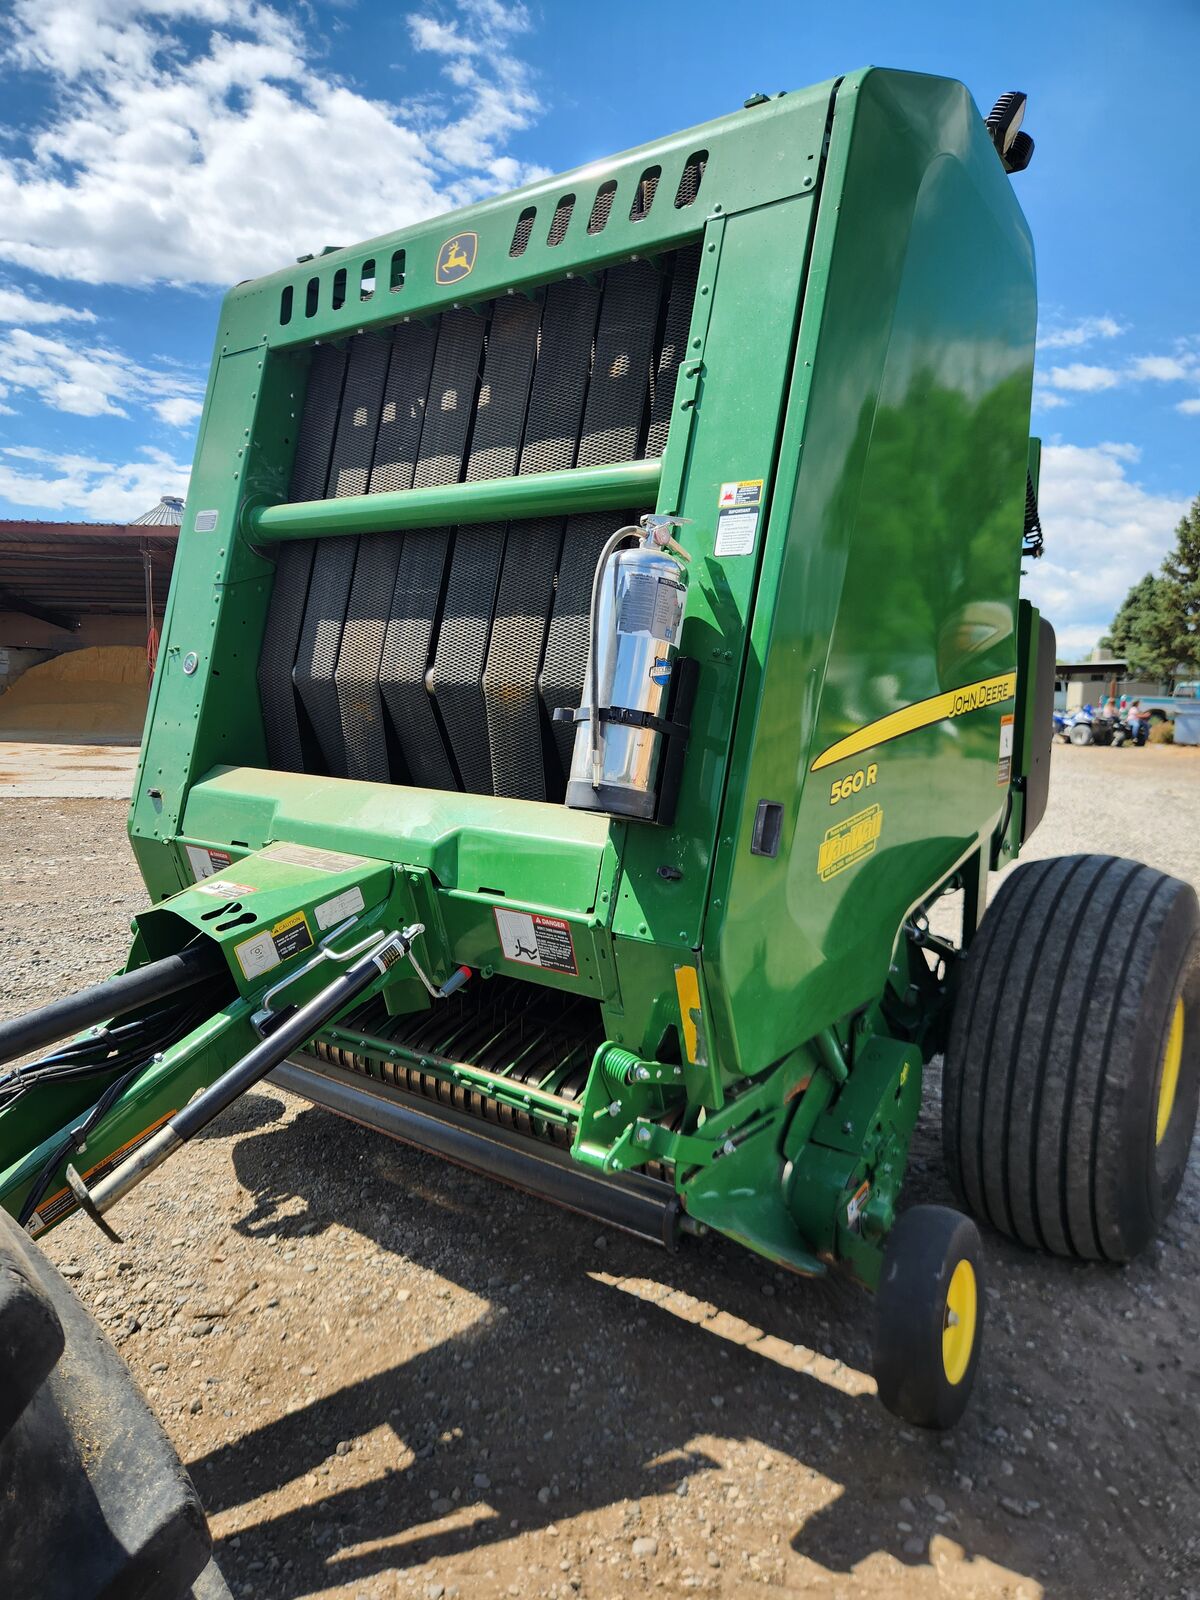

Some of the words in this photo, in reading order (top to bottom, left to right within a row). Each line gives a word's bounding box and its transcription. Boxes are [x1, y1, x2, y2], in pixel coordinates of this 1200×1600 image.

[950, 692, 977, 714] JOHN
[979, 682, 1009, 704] DEERE
[829, 770, 864, 805] 560
[279, 916, 301, 930] CAUTION
[541, 918, 566, 929] DANGER
